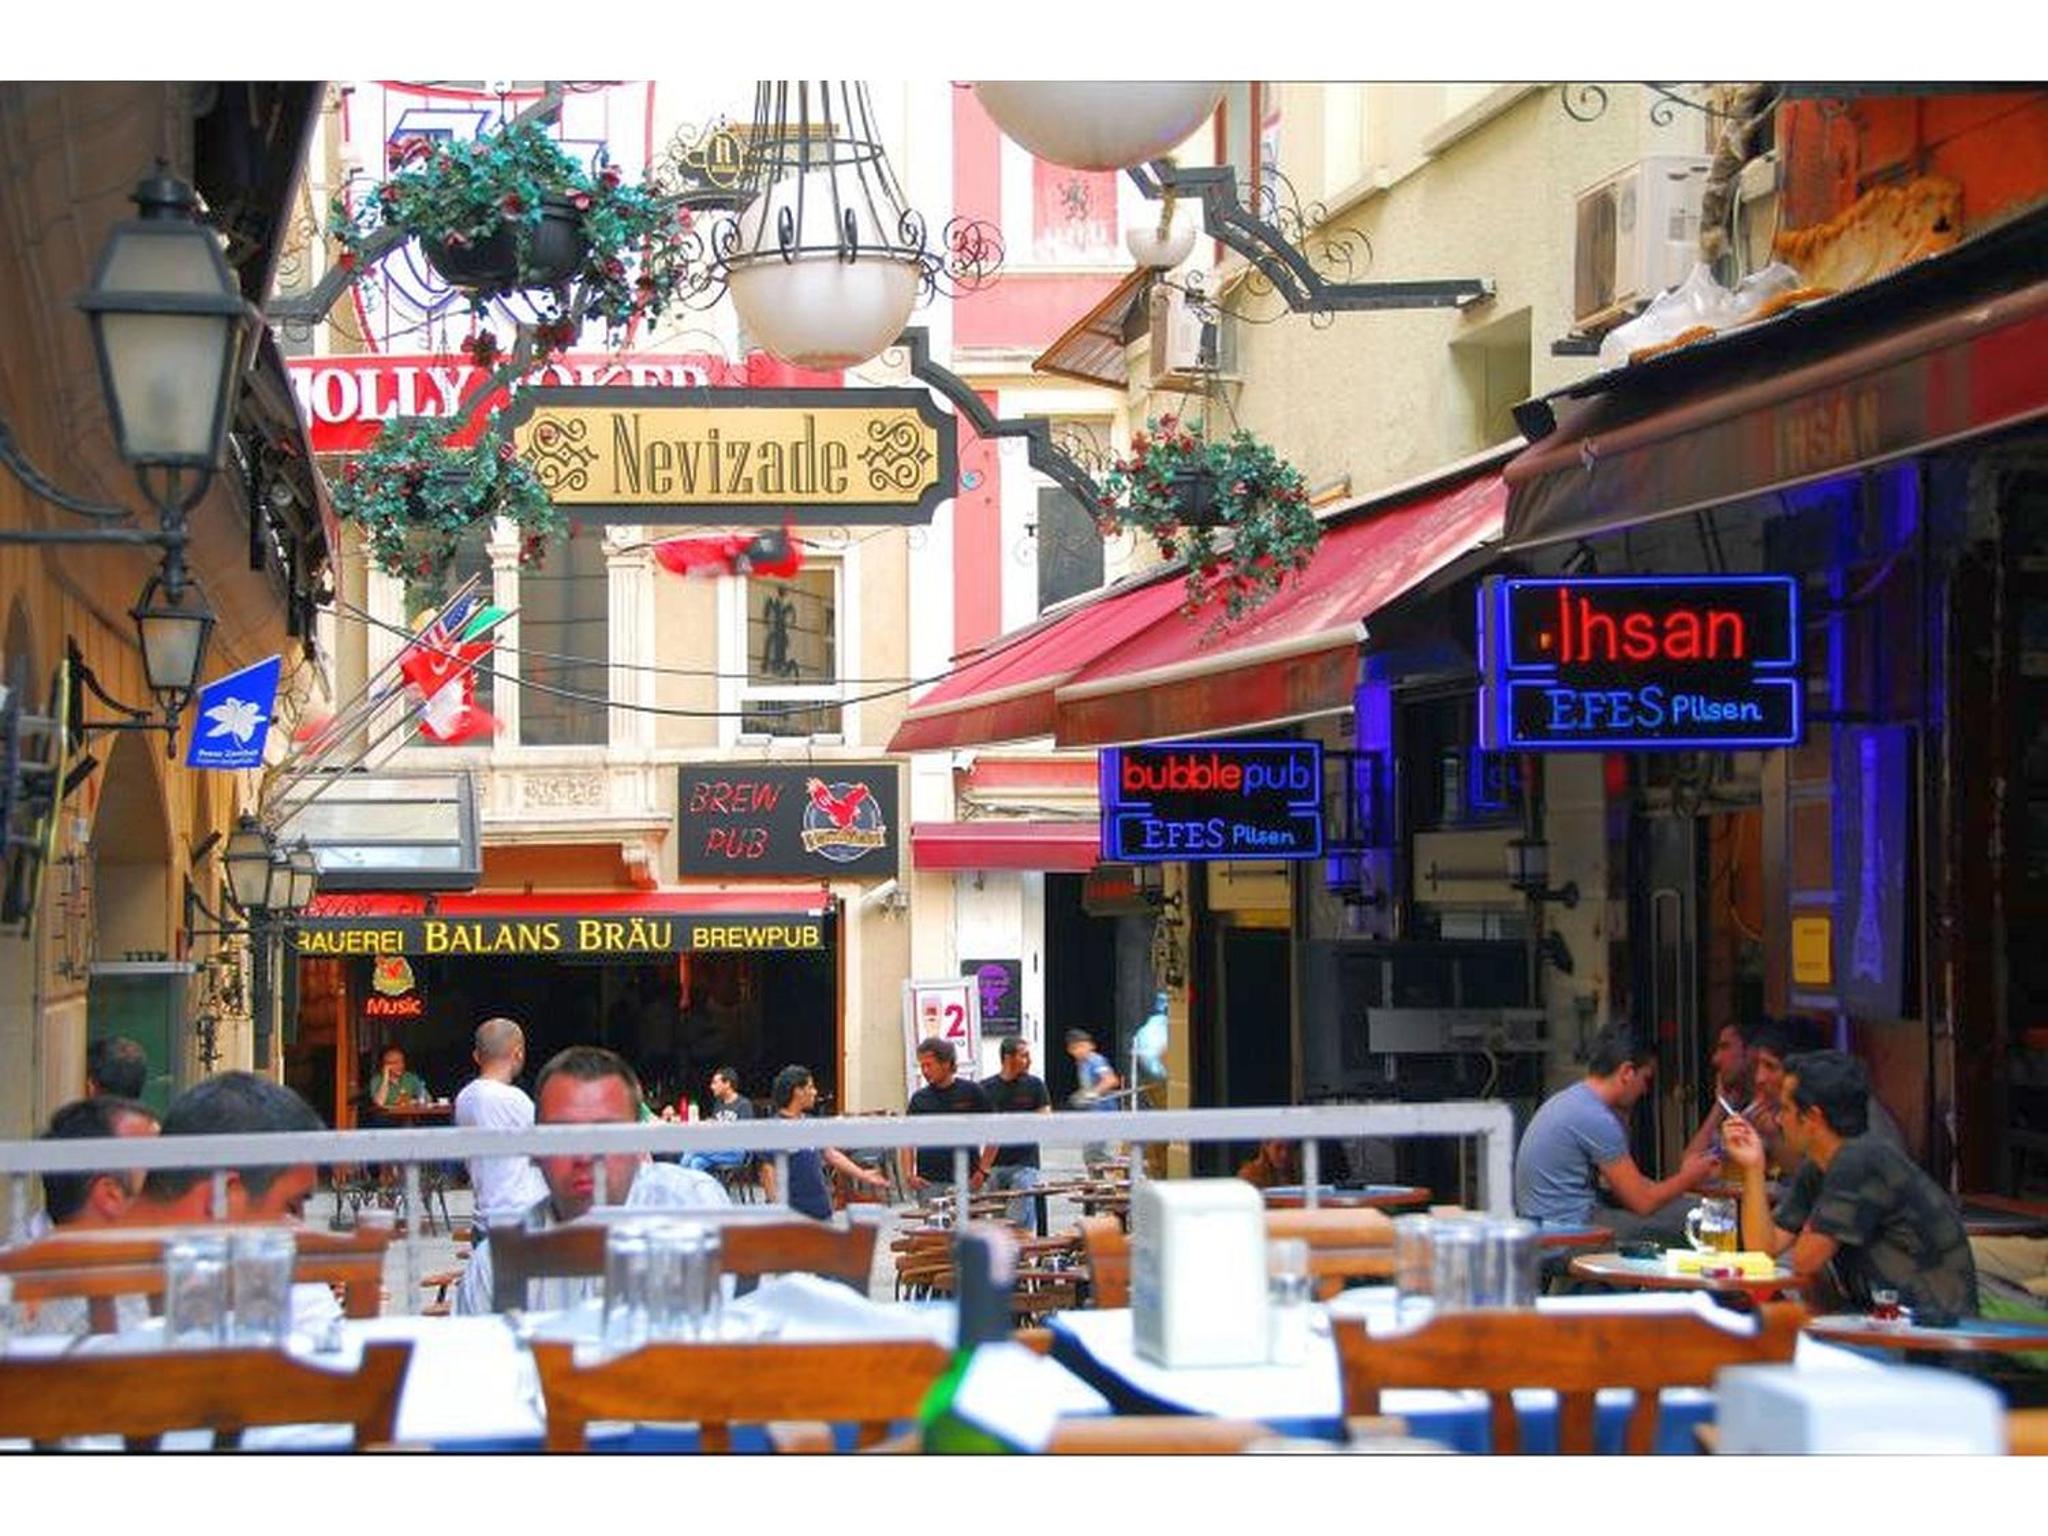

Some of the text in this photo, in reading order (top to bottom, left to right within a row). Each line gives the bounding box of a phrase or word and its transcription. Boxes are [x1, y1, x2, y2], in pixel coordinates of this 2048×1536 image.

[612, 413, 849, 494] Nevizade
[1541, 685, 1763, 730] EFES Pilsen
[689, 778, 782, 816] BREW
[704, 826, 770, 858] PUB
[1140, 817, 1296, 849] EFES Pilsen
[422, 920, 561, 954] BALANS
[577, 917, 672, 951] BRÄU
[692, 925, 819, 949] BREWPUB
[366, 996, 421, 1015] Music
[944, 1004, 966, 1038] 2
